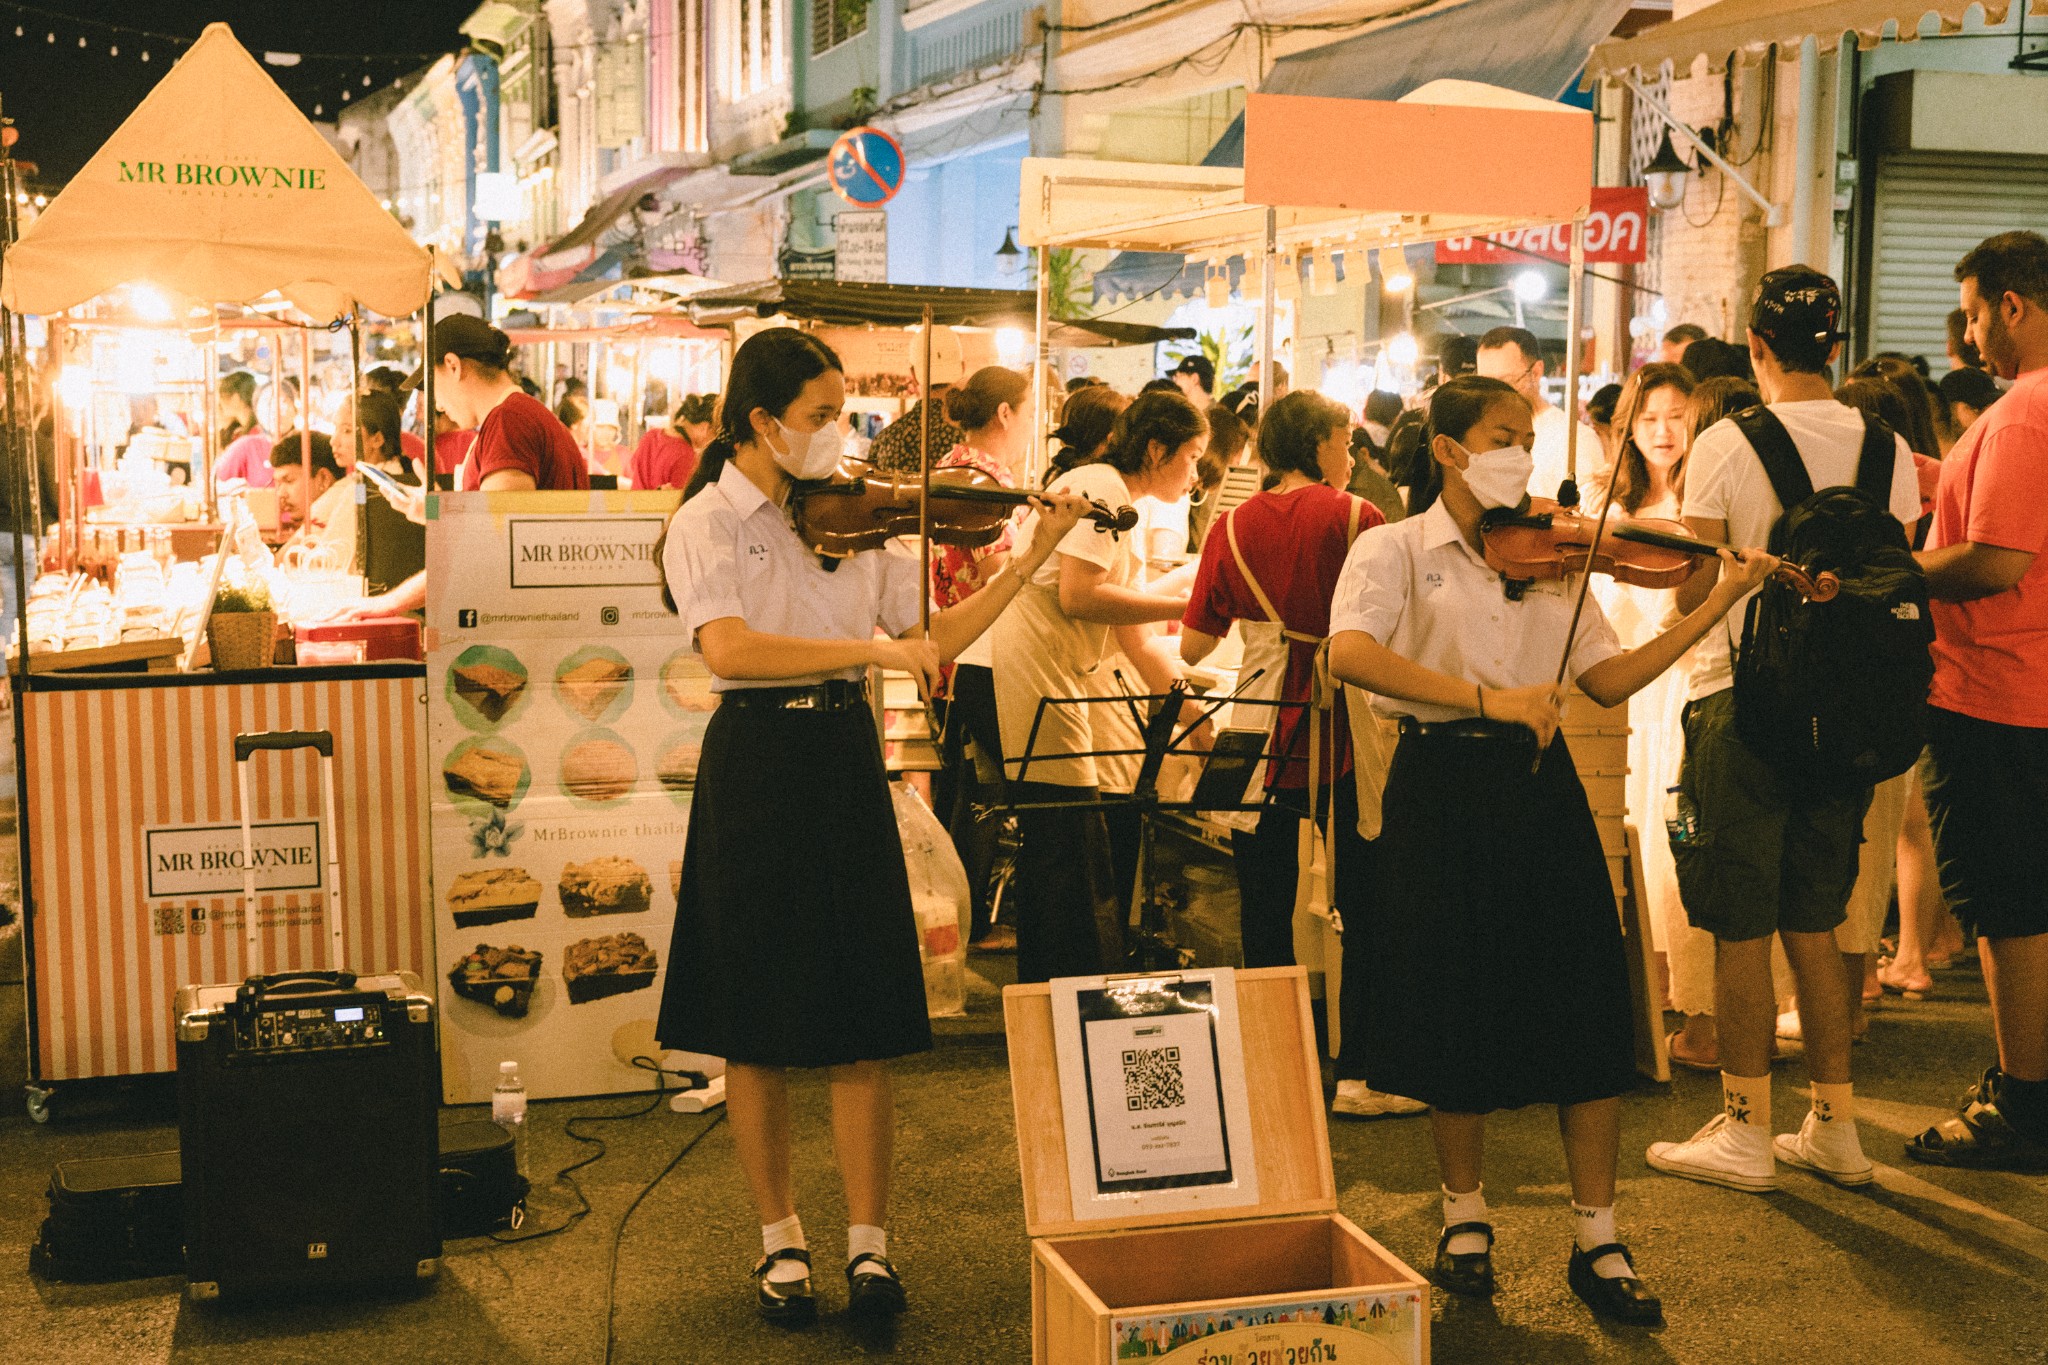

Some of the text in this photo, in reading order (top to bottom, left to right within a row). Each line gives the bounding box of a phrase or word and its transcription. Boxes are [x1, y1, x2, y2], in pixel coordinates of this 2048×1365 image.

[117, 160, 326, 190] MR BROWNIE
[520, 544, 553, 562] MR
[480, 611, 580, 625] @mrbrowniethailand
[534, 822, 686, 842] MrBrownie thaila
[158, 847, 313, 872] MR BROWNIE
[1814, 1099, 1831, 1112] t's
